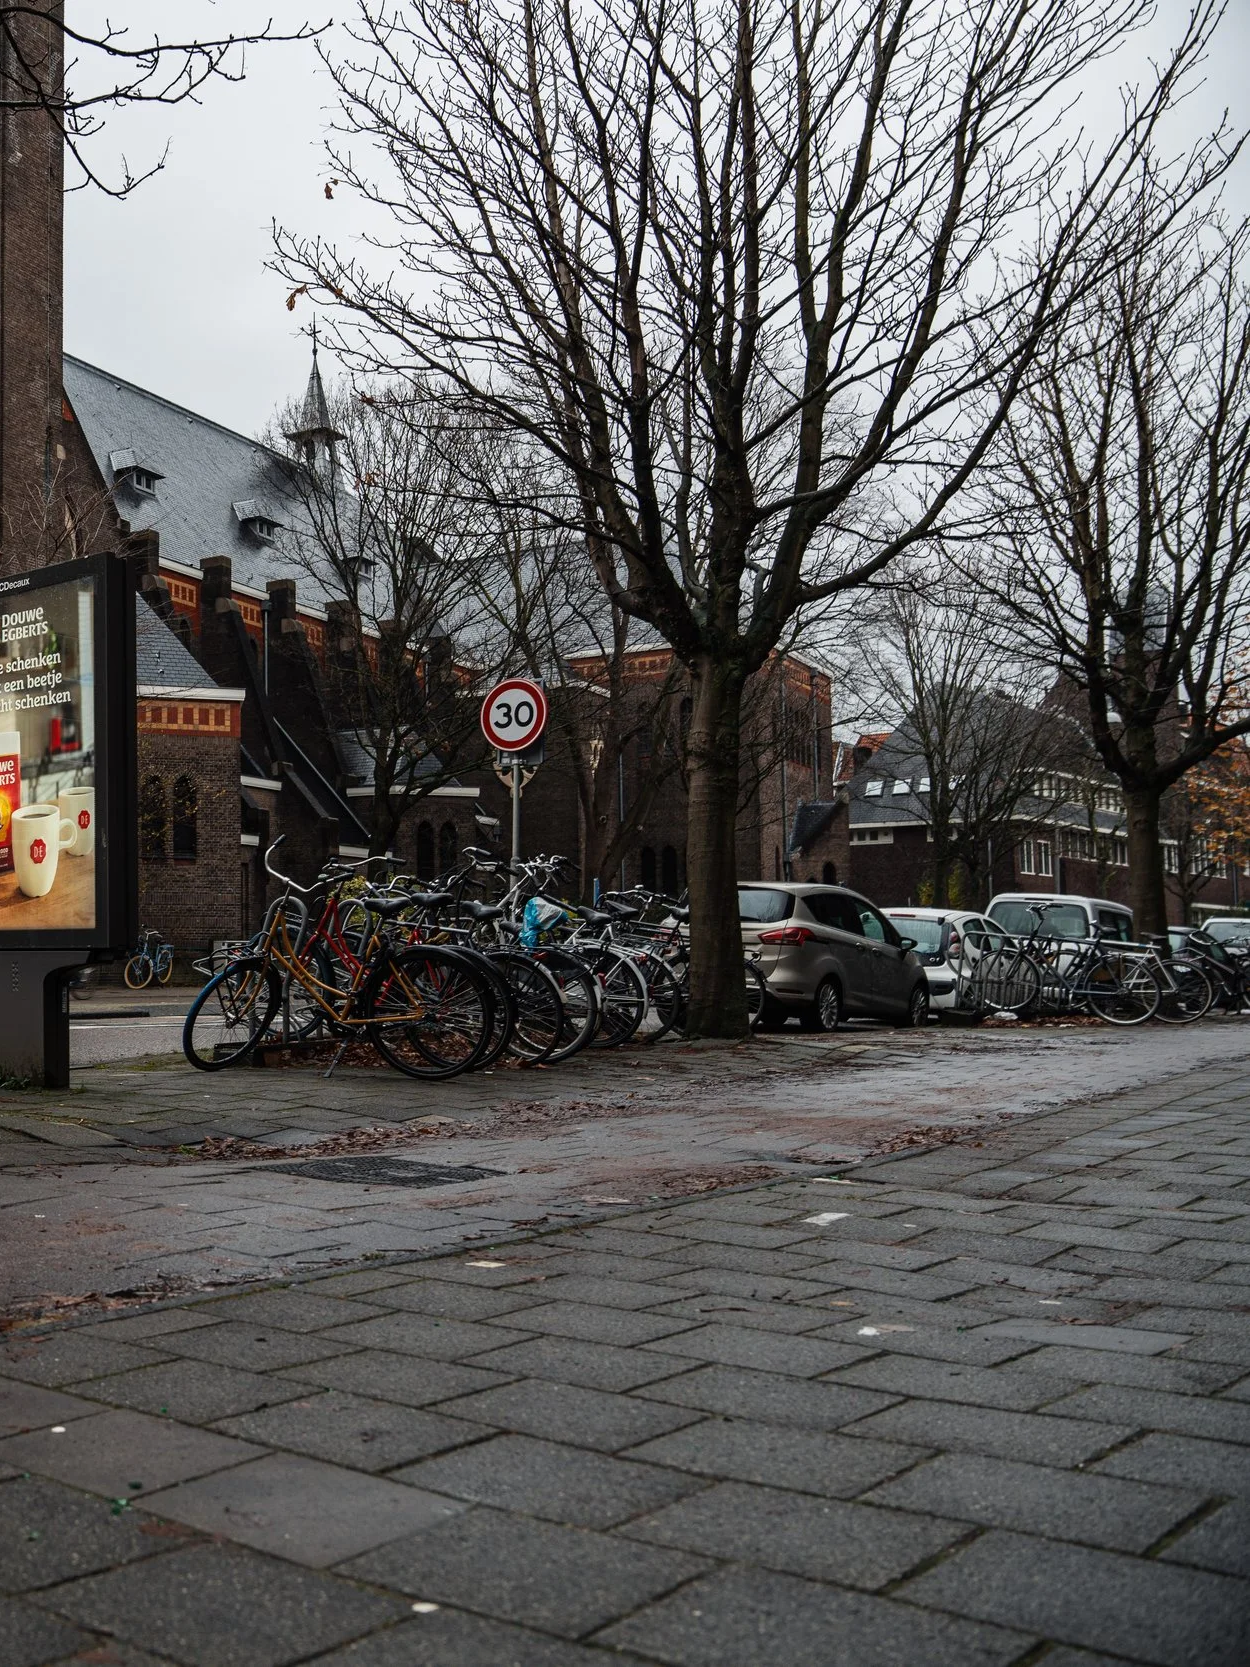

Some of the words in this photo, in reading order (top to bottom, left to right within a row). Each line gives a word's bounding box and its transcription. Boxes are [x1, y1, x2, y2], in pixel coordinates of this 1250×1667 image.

[1, 621, 49, 643] EGBERTS
[5, 652, 62, 673] schenken
[3, 679, 25, 693] een
[26, 669, 63, 689] beetje
[15, 690, 72, 710] schenken
[493, 701, 534, 729] 30
